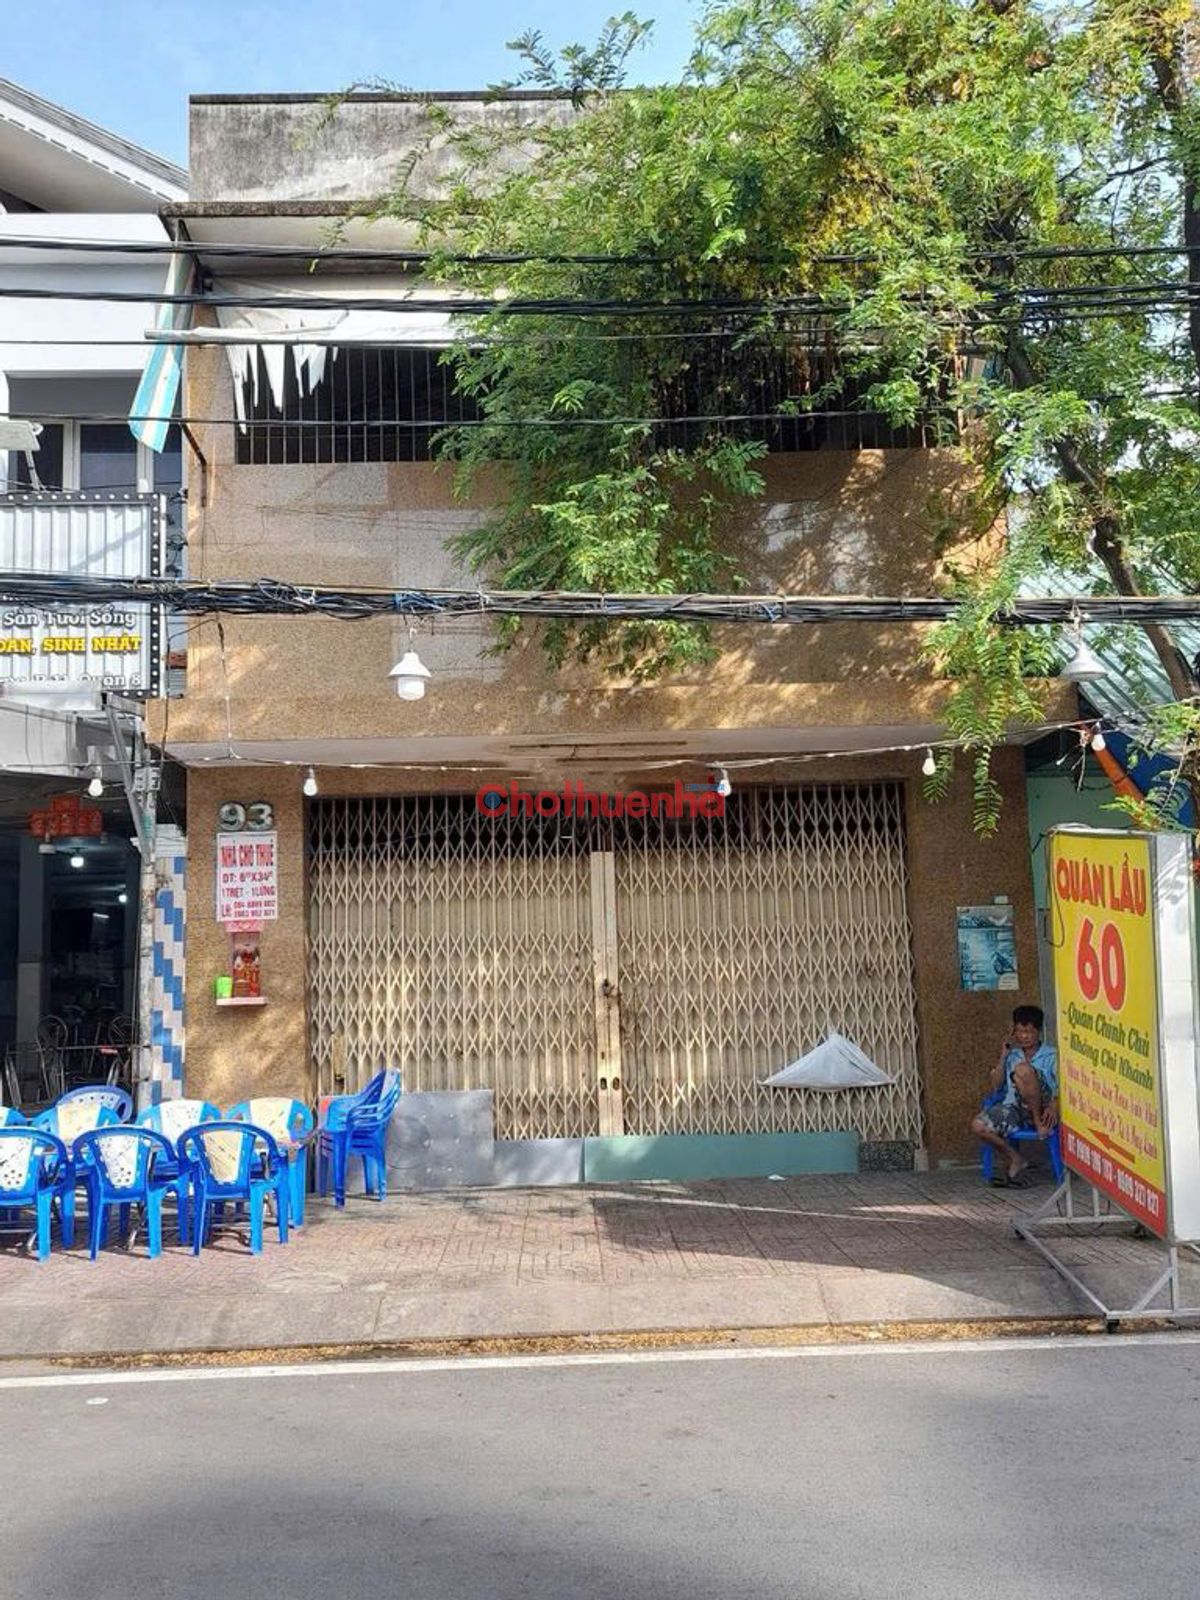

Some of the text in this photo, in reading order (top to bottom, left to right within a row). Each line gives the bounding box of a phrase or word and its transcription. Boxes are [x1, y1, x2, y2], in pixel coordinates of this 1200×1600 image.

[90, 605, 136, 630] Sống
[43, 637, 85, 653] SINH
[92, 633, 141, 655] NHẬT
[218, 800, 274, 832] 93
[1055, 857, 1106, 908] QUÁN
[1077, 918, 1126, 1011] 60
